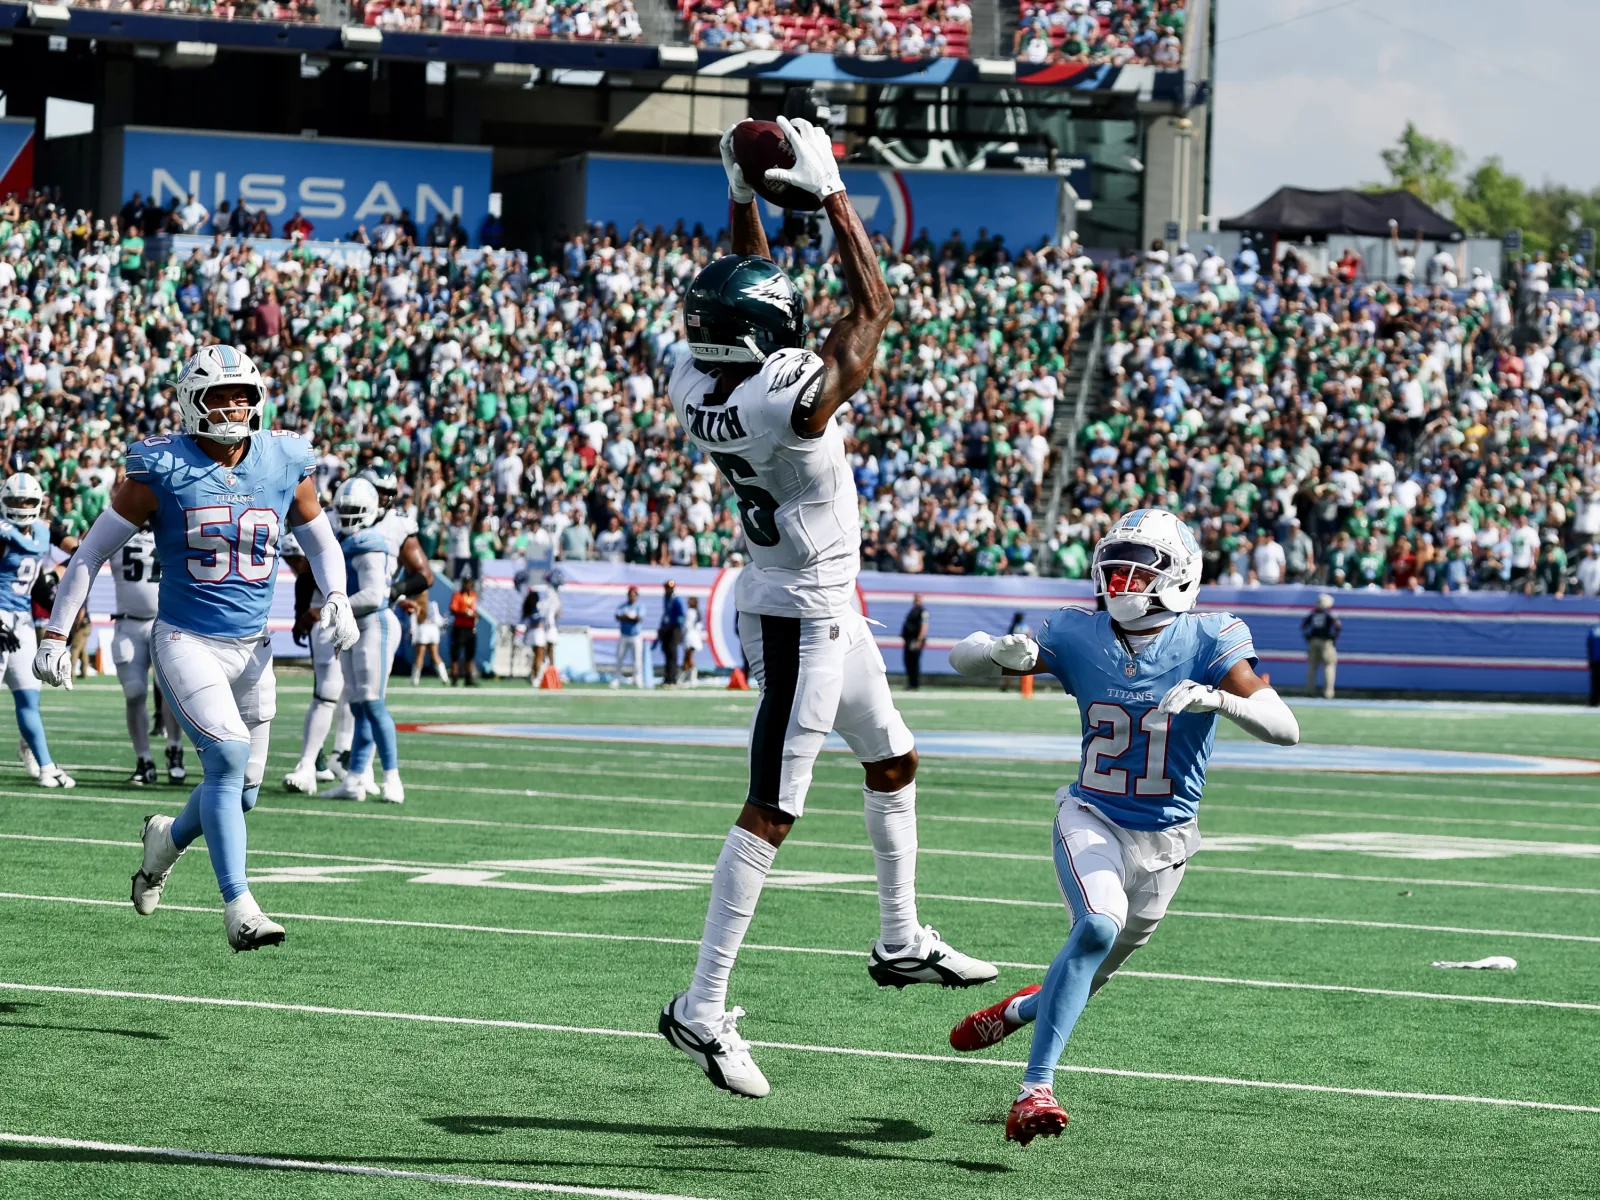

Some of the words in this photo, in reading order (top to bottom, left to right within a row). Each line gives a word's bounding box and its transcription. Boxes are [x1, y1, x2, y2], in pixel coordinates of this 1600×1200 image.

[152, 168, 464, 223] NISSAN
[213, 494, 255, 502] TITANS
[710, 452, 781, 547] 6
[184, 506, 280, 583] 50
[1107, 688, 1154, 701] TITANS
[1080, 701, 1175, 797] 21
